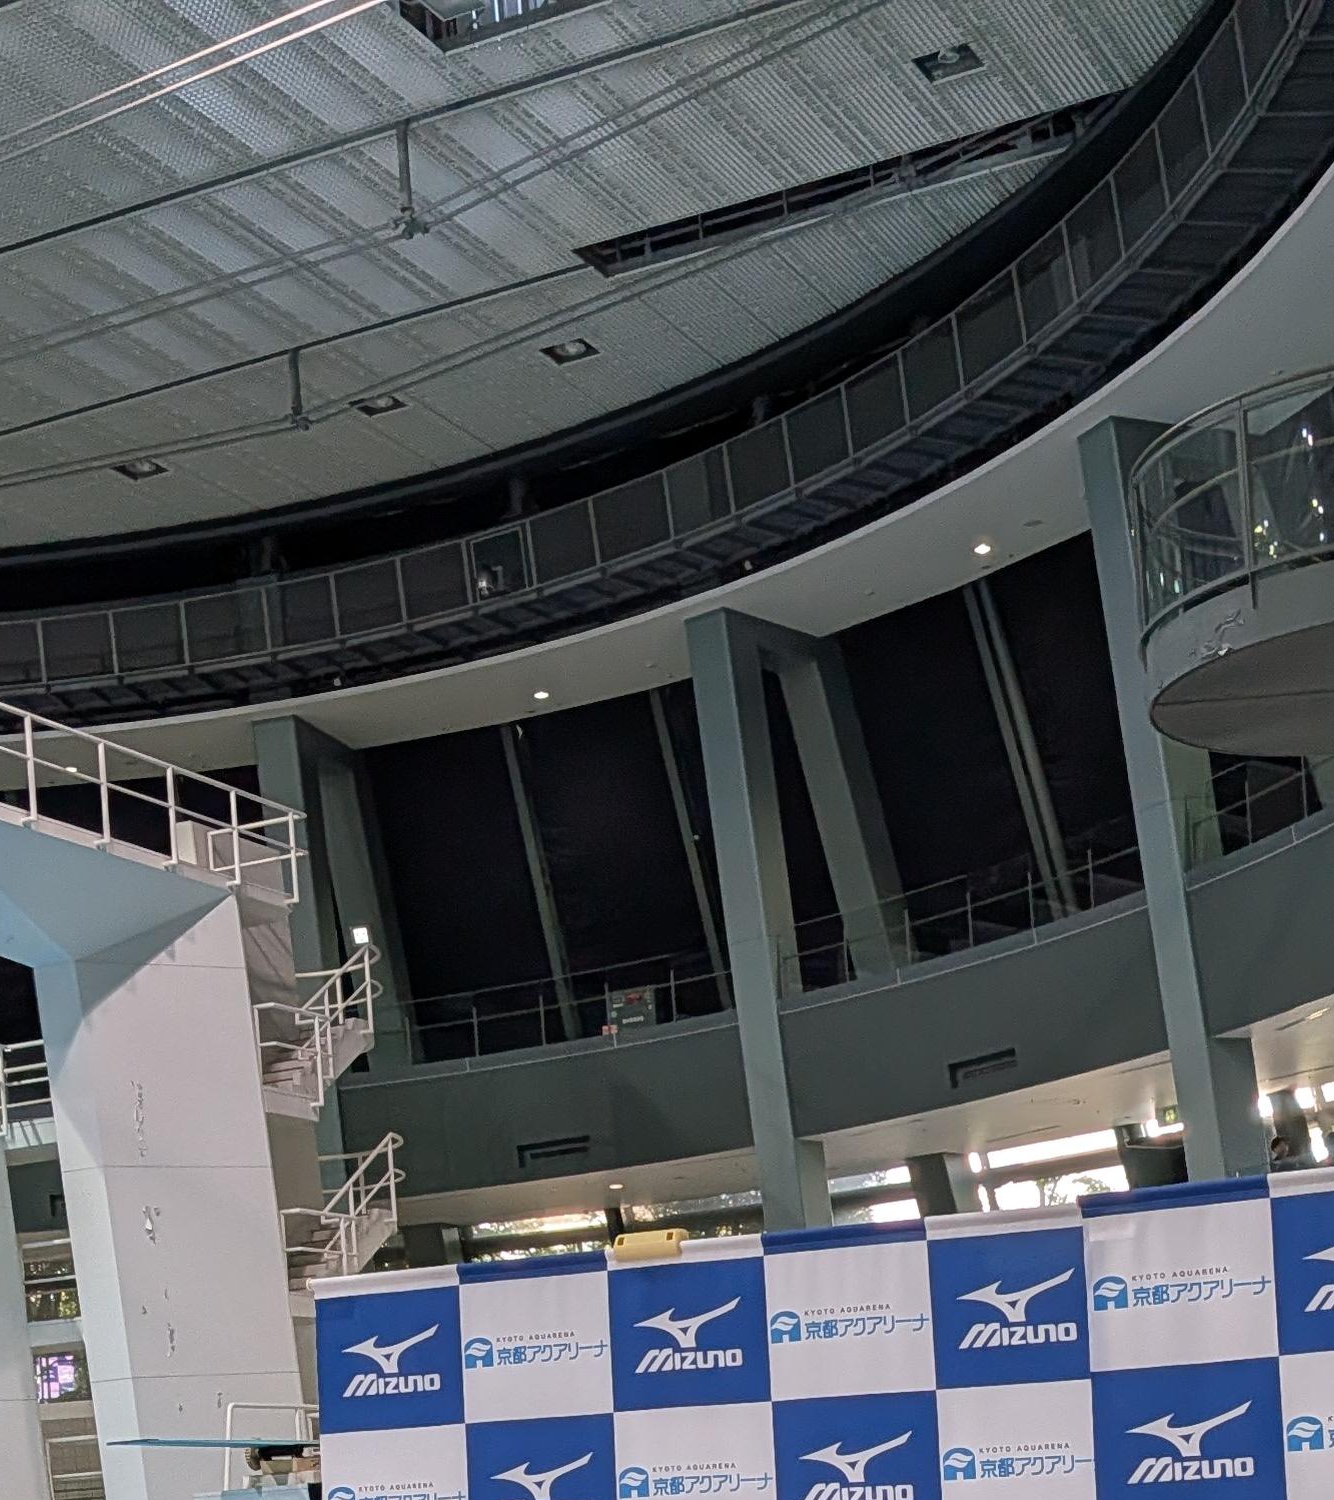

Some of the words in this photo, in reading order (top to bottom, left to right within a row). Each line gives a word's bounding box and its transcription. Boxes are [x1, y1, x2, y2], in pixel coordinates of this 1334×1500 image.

[1131, 1272, 1166, 1282] KYOTO
[1171, 1266, 1228, 1278] AQUARENA
[1132, 1276, 1271, 1305] 京都アクアリーナ
[805, 1314, 929, 1339] 京都アクアリーナ
[959, 1323, 1077, 1349] MIZUNO
[497, 1341, 607, 1365] 京都アクアリーナ
[636, 1348, 742, 1373] MIZUNO
[343, 1374, 440, 1397] MIZUNO
[980, 1456, 1093, 1477] 京都アクアリー
[1128, 1457, 1254, 1484] MIZUNO
[653, 1473, 772, 1495] 京都アクアリーナ
